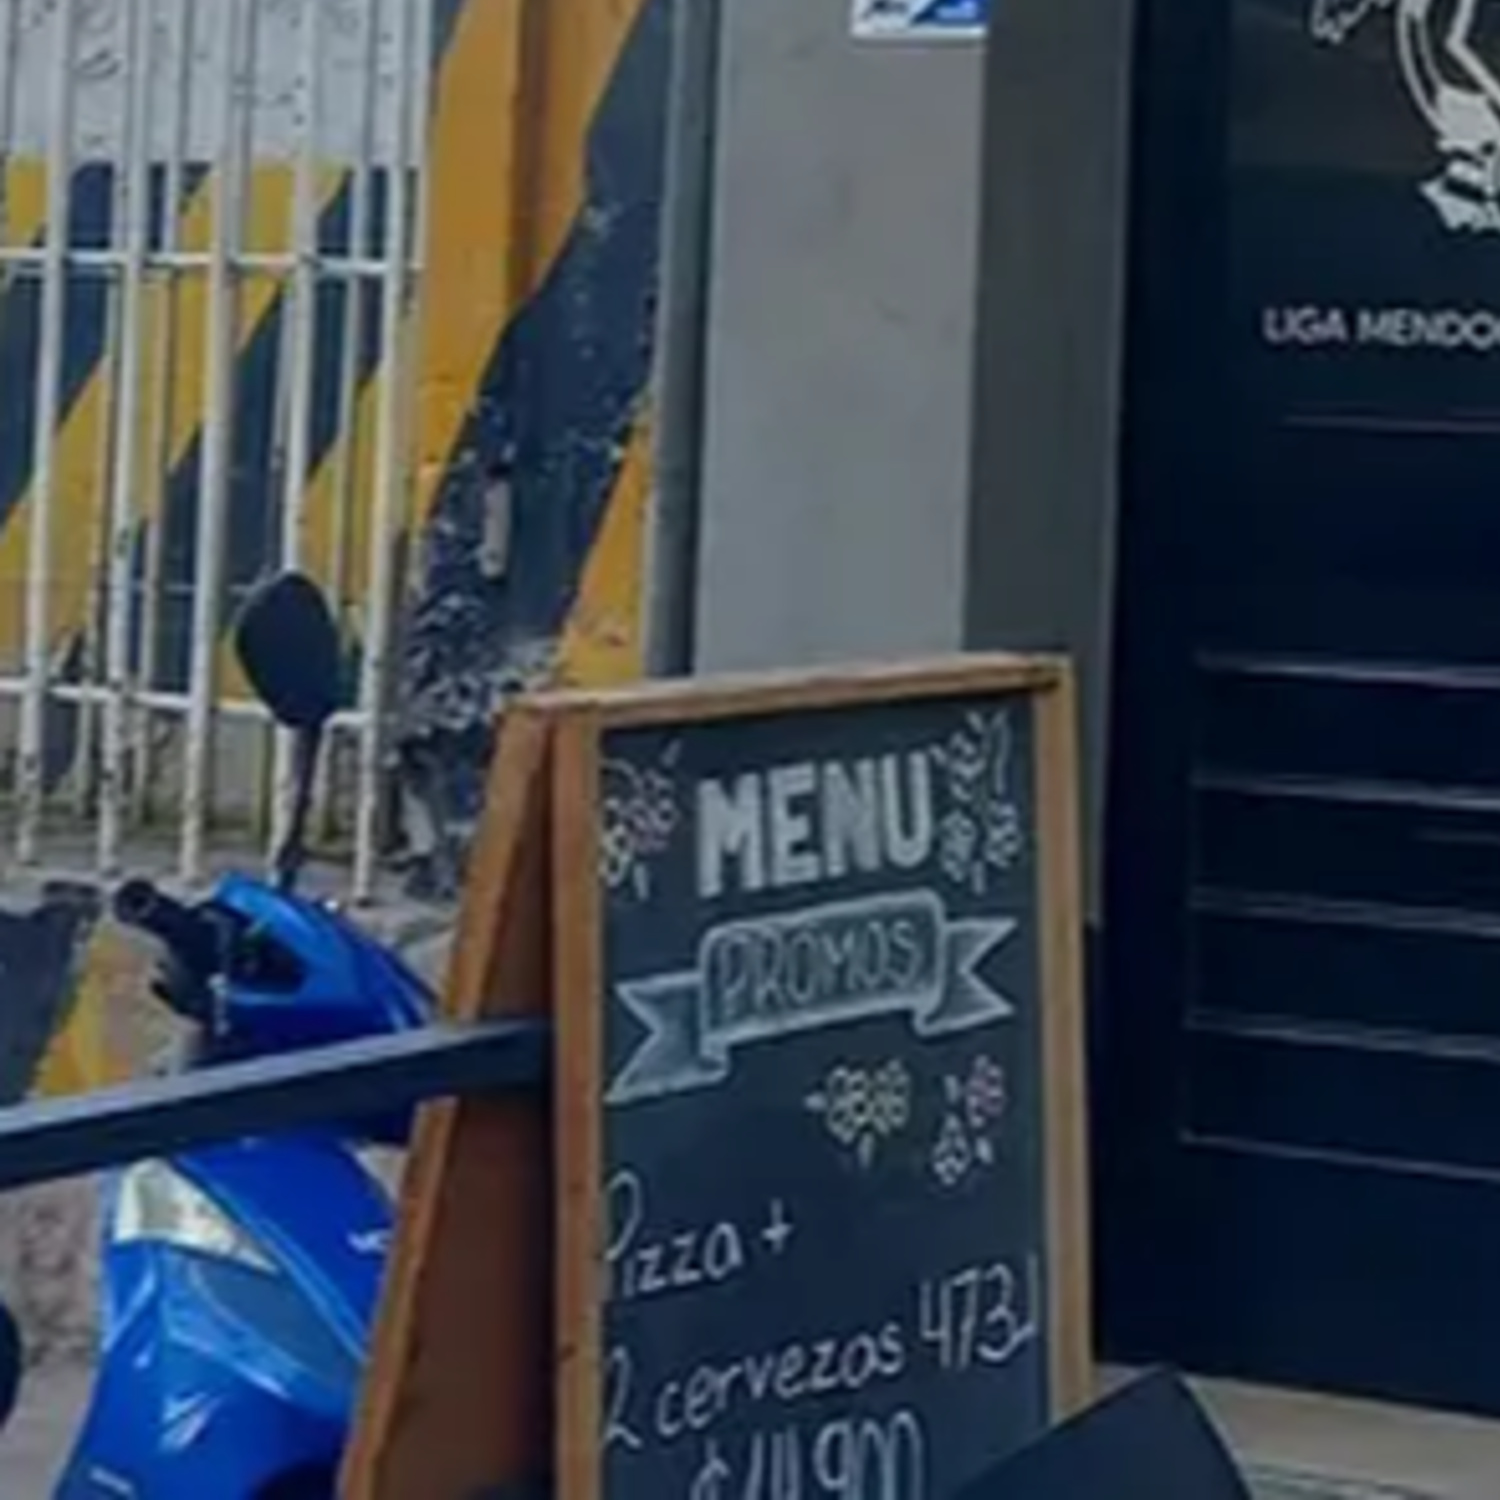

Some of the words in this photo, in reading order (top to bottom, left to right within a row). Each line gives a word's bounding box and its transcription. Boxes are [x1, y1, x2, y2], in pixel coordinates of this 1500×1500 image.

[1262, 307, 1349, 344] LIGA
[697, 750, 932, 898] MENU
[718, 920, 918, 1020] PROMOS
